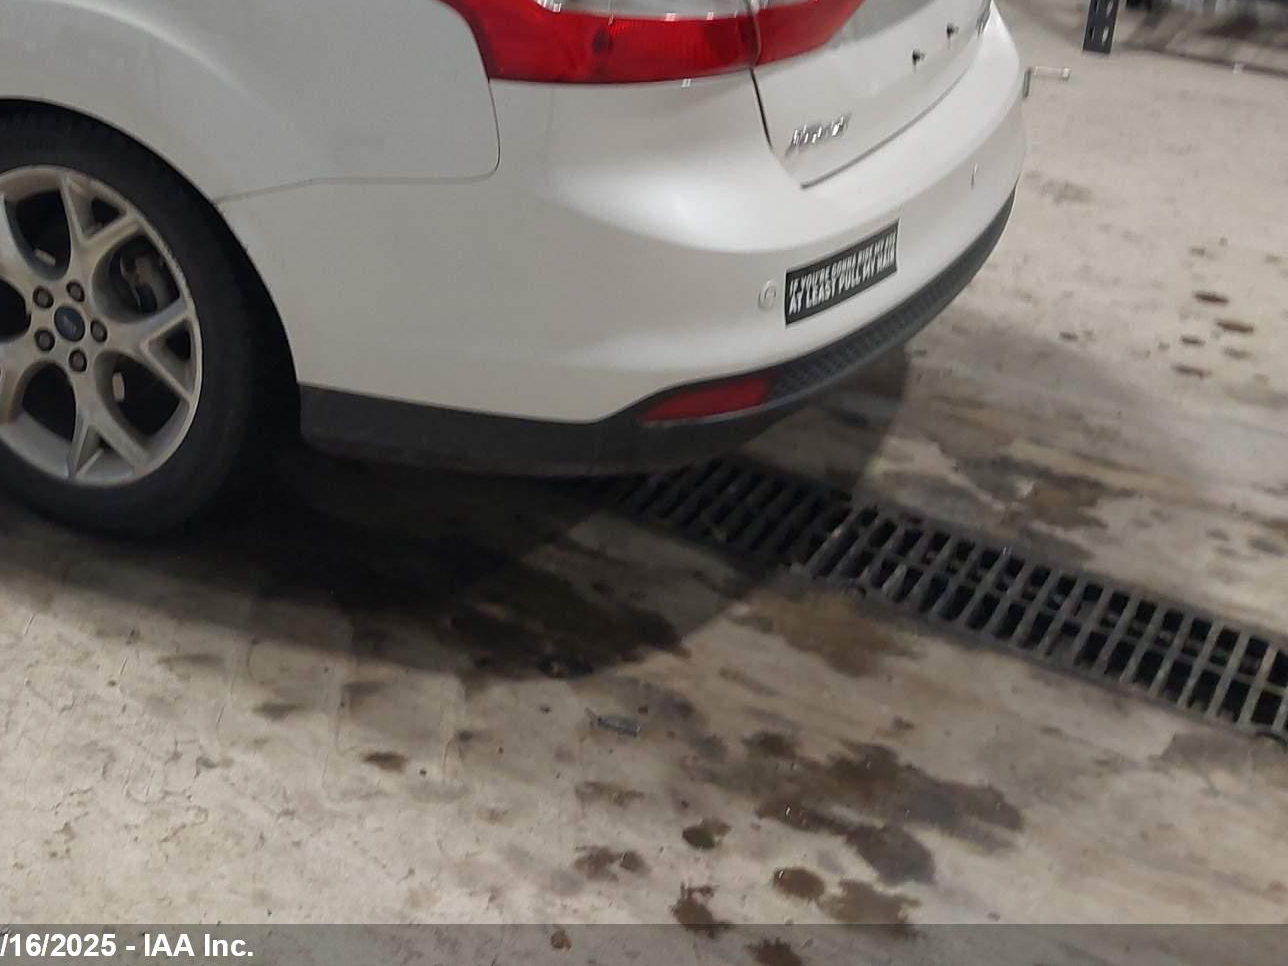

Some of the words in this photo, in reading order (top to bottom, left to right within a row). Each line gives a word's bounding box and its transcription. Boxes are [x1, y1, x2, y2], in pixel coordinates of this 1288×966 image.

[789, 277, 800, 298] IF
[800, 265, 831, 292] YOU'RE
[832, 253, 857, 280] GONNA
[789, 291, 803, 315] AT
[806, 278, 837, 309] LEAST
[838, 266, 861, 294] PULL
[862, 259, 876, 281] MY
